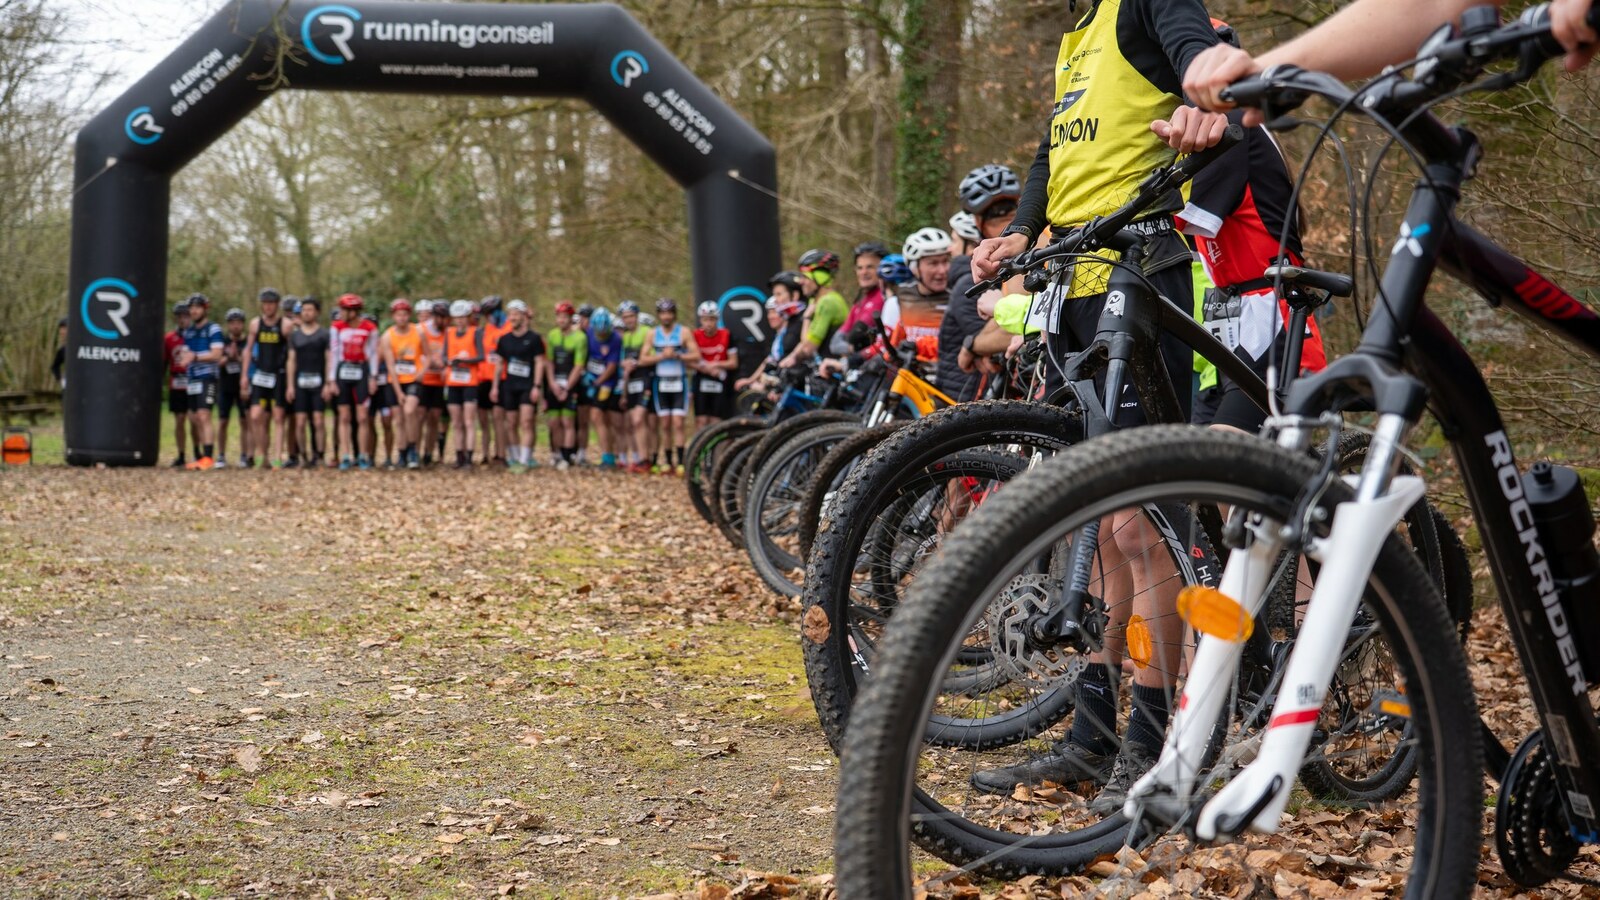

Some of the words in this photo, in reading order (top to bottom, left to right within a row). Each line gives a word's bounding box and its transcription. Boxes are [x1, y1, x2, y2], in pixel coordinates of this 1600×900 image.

[363, 19, 554, 48] runningconseil
[170, 48, 224, 97] ALENÇON
[662, 88, 716, 136] ALENÇON
[78, 346, 141, 363] ALENÇON
[946, 460, 1019, 476] HUTCHINSO
[1484, 429, 1587, 697] ROCKRIDER
